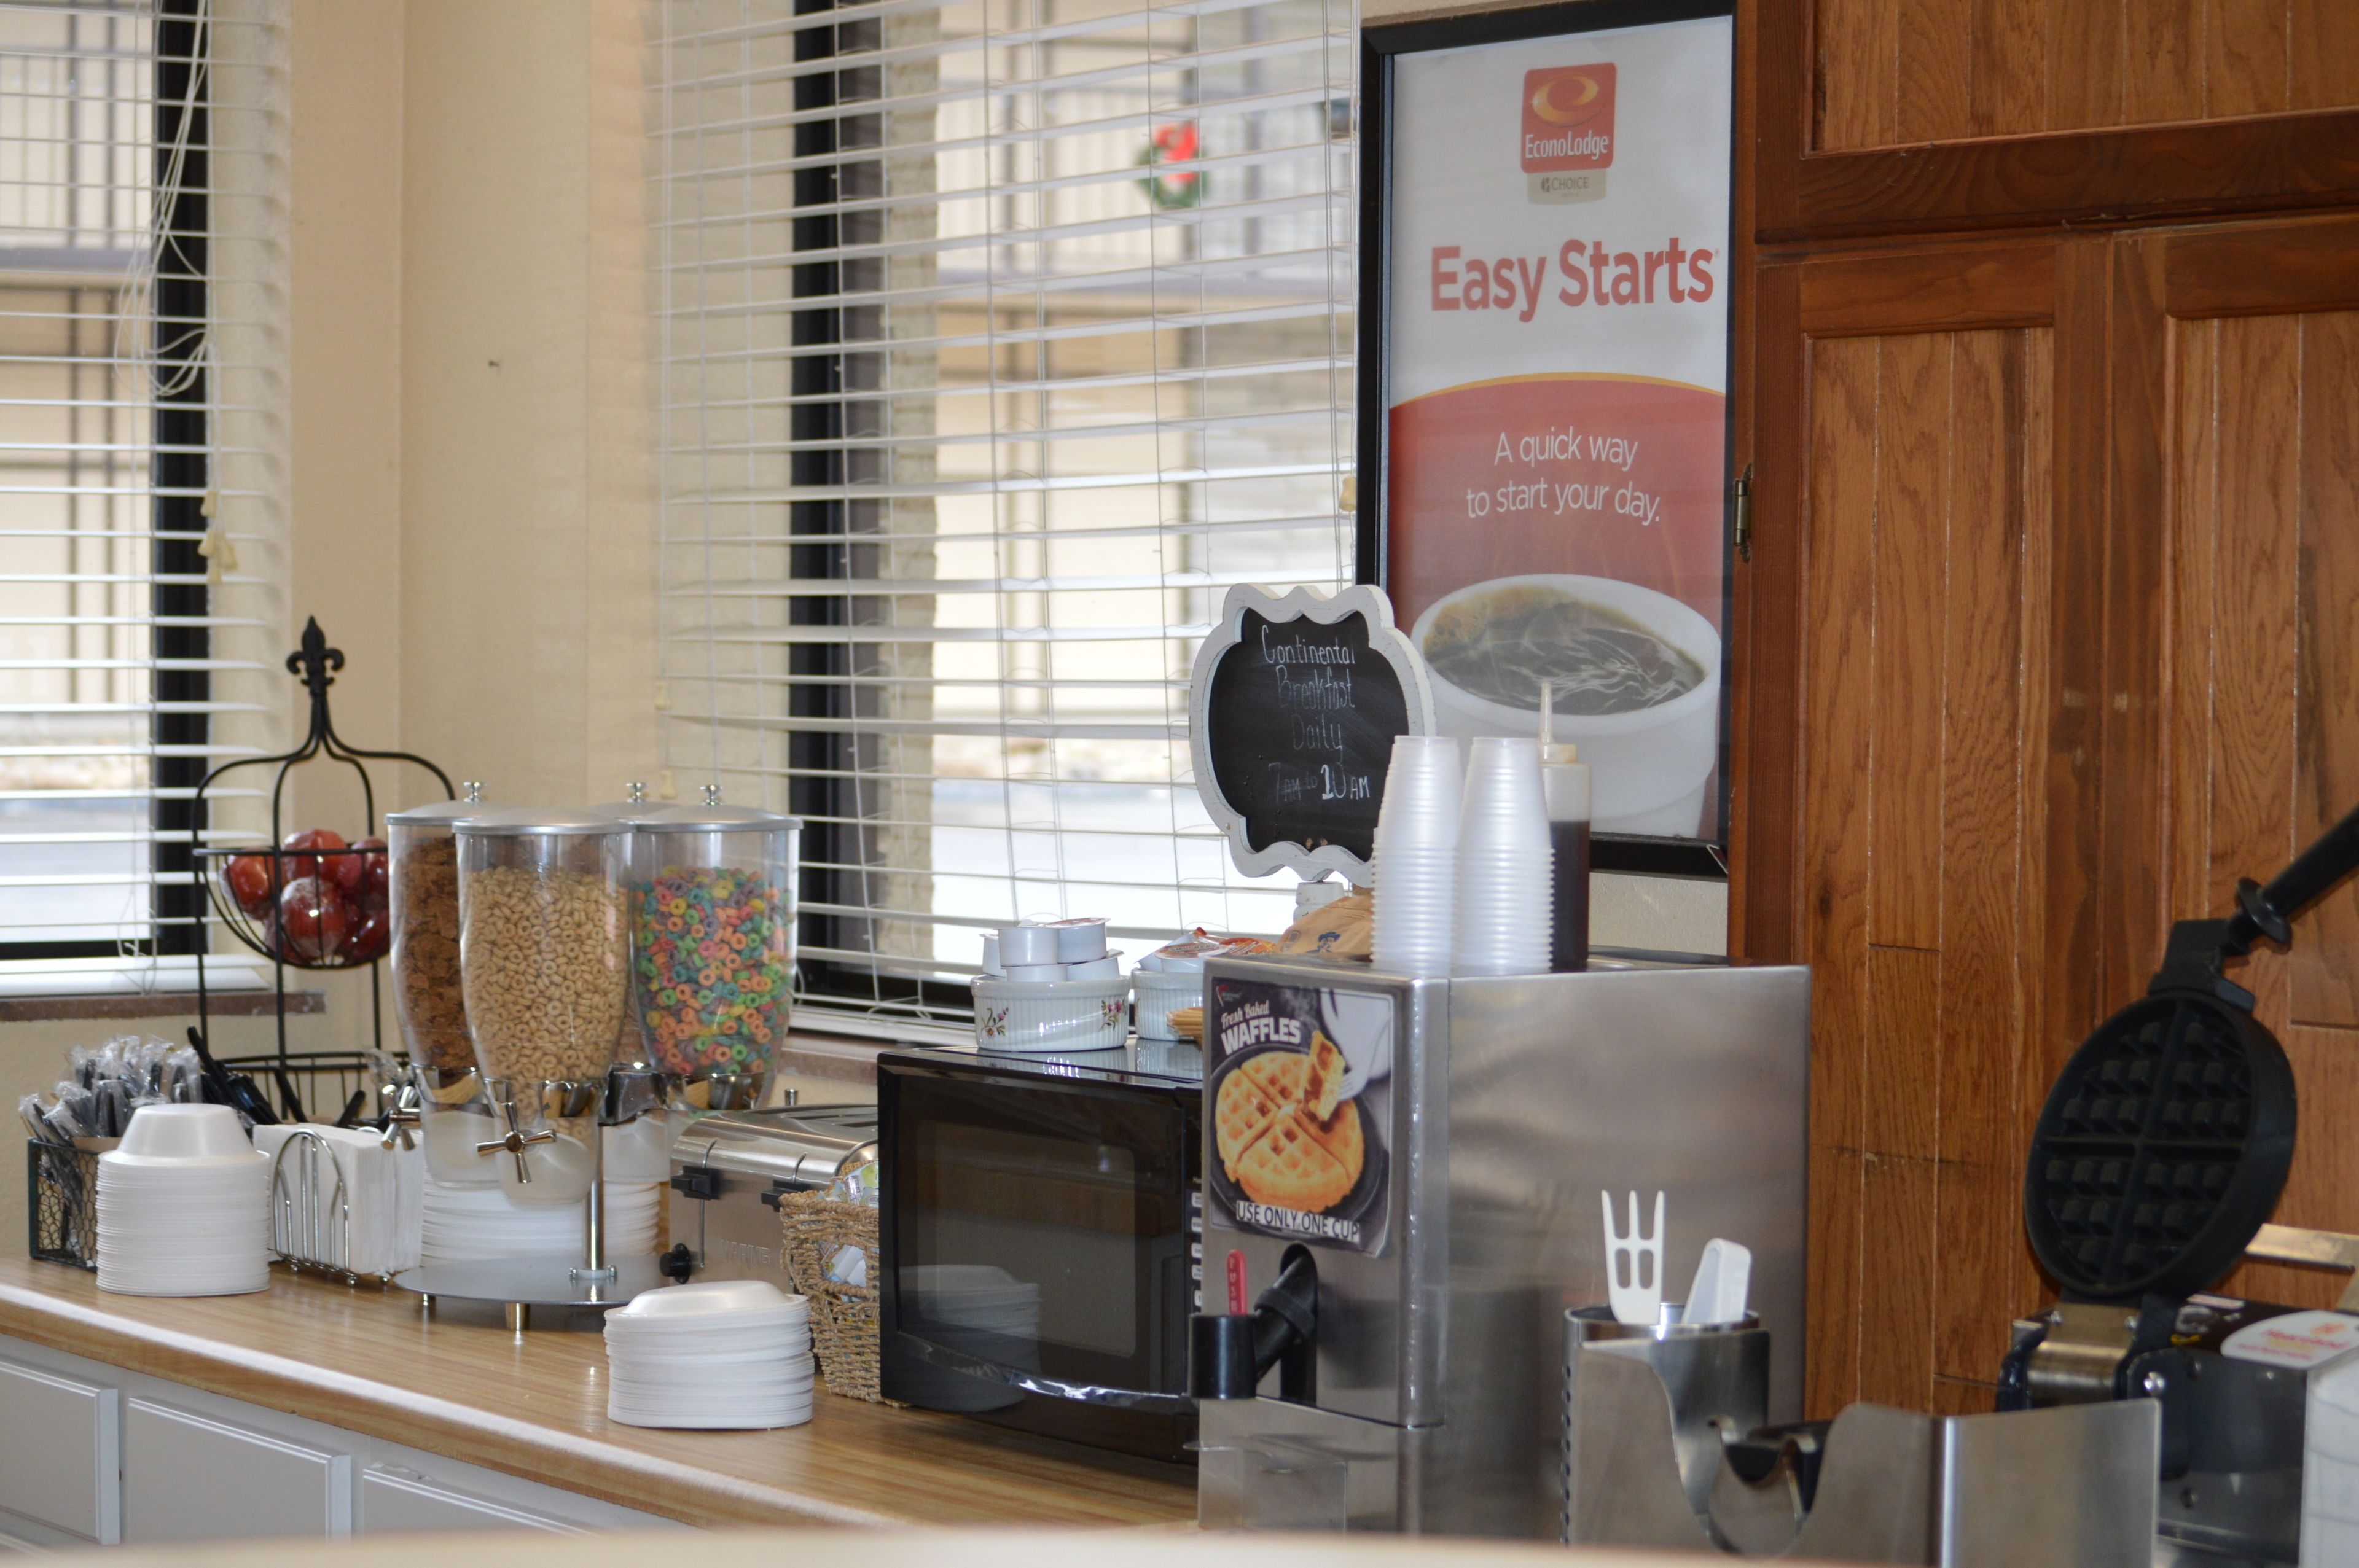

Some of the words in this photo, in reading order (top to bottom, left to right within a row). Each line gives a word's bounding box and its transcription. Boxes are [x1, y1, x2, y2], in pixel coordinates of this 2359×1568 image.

[1552, 176, 1590, 191] CHOICE
[1431, 246, 1547, 322] Easy
[1559, 237, 1714, 307] Starts
[1495, 432, 1513, 465] A
[1520, 426, 1582, 467] quick
[1589, 435, 1638, 472] way
[1466, 489, 1490, 518] to
[1496, 477, 1547, 512] start
[1554, 483, 1609, 515] your
[1614, 481, 1660, 526] day.
[1262, 625, 1355, 665] Continental
[1276, 665, 1355, 709] Breakfast
[1291, 714, 1342, 762] Daily
[1221, 1007, 1243, 1030] Fresh
[1244, 1000, 1270, 1020] Baked
[1221, 1017, 1301, 1056] WAFFLES
[1237, 1202, 1260, 1221] USE
[1264, 1207, 1297, 1228] ONLY
[1302, 1213, 1328, 1234] ONE
[1332, 1219, 1359, 1241] CUP
